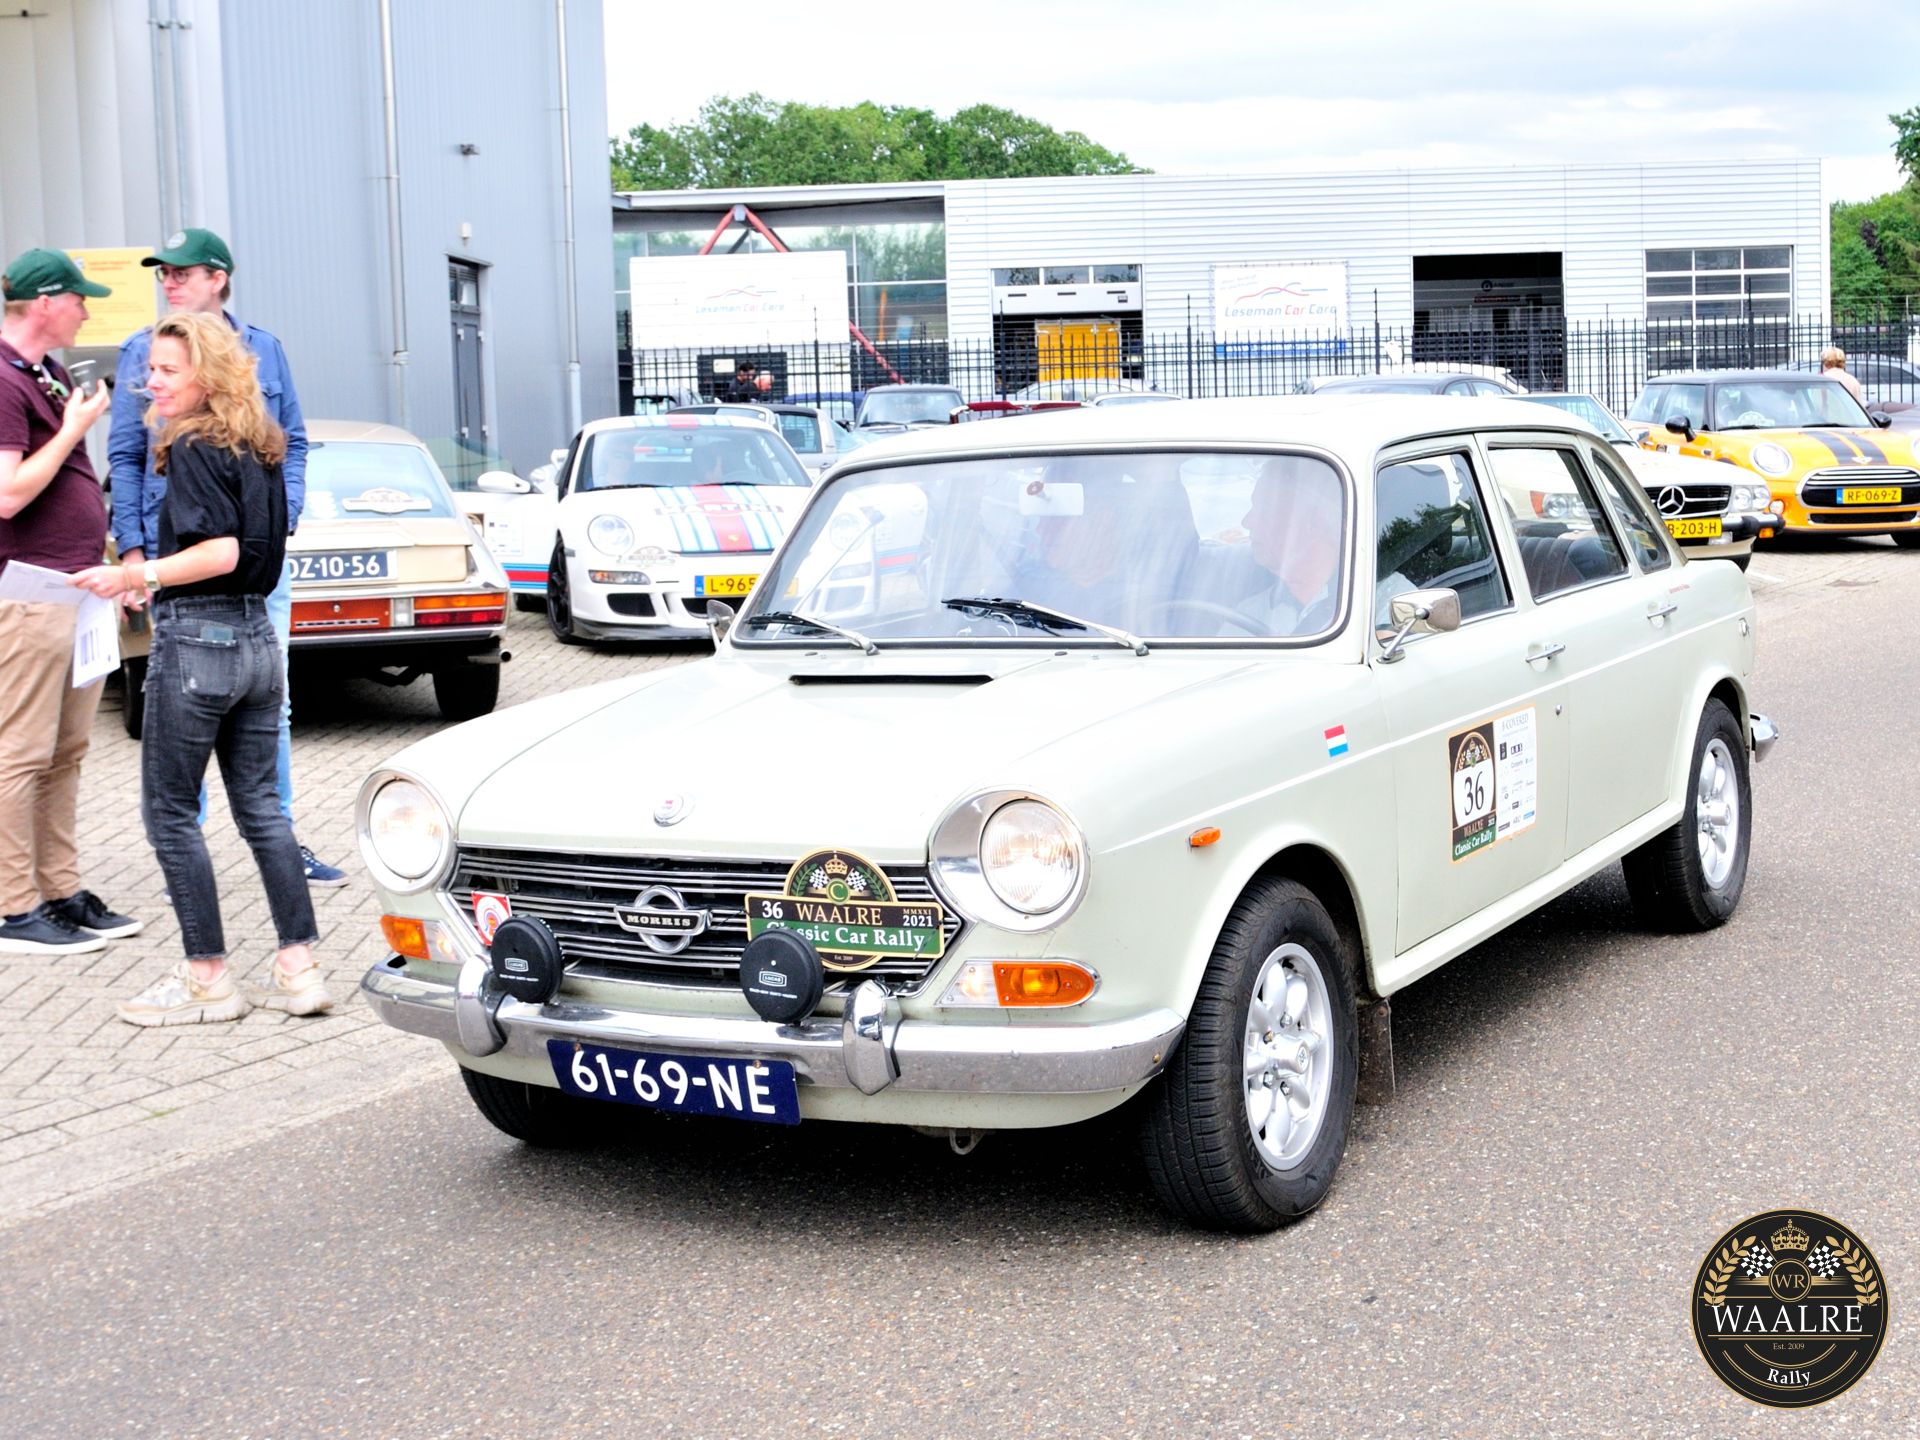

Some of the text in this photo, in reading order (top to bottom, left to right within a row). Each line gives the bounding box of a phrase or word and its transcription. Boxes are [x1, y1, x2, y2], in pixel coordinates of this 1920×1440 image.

[1224, 306, 1282, 317] Leseman
[1284, 304, 1305, 316] Car
[1847, 489, 1898, 501] RF-069-Z
[1464, 770, 1485, 817] 36
[1463, 819, 1484, 838] WAALRE
[1455, 830, 1493, 856] Classic Car Rally
[626, 914, 691, 927] MORRIS
[762, 901, 883, 926] 36 WAALRE
[902, 914, 934, 928] 2021
[835, 927, 868, 945] Car
[874, 929, 925, 952] Rally
[571, 1050, 776, 1115] 61-69-NE
